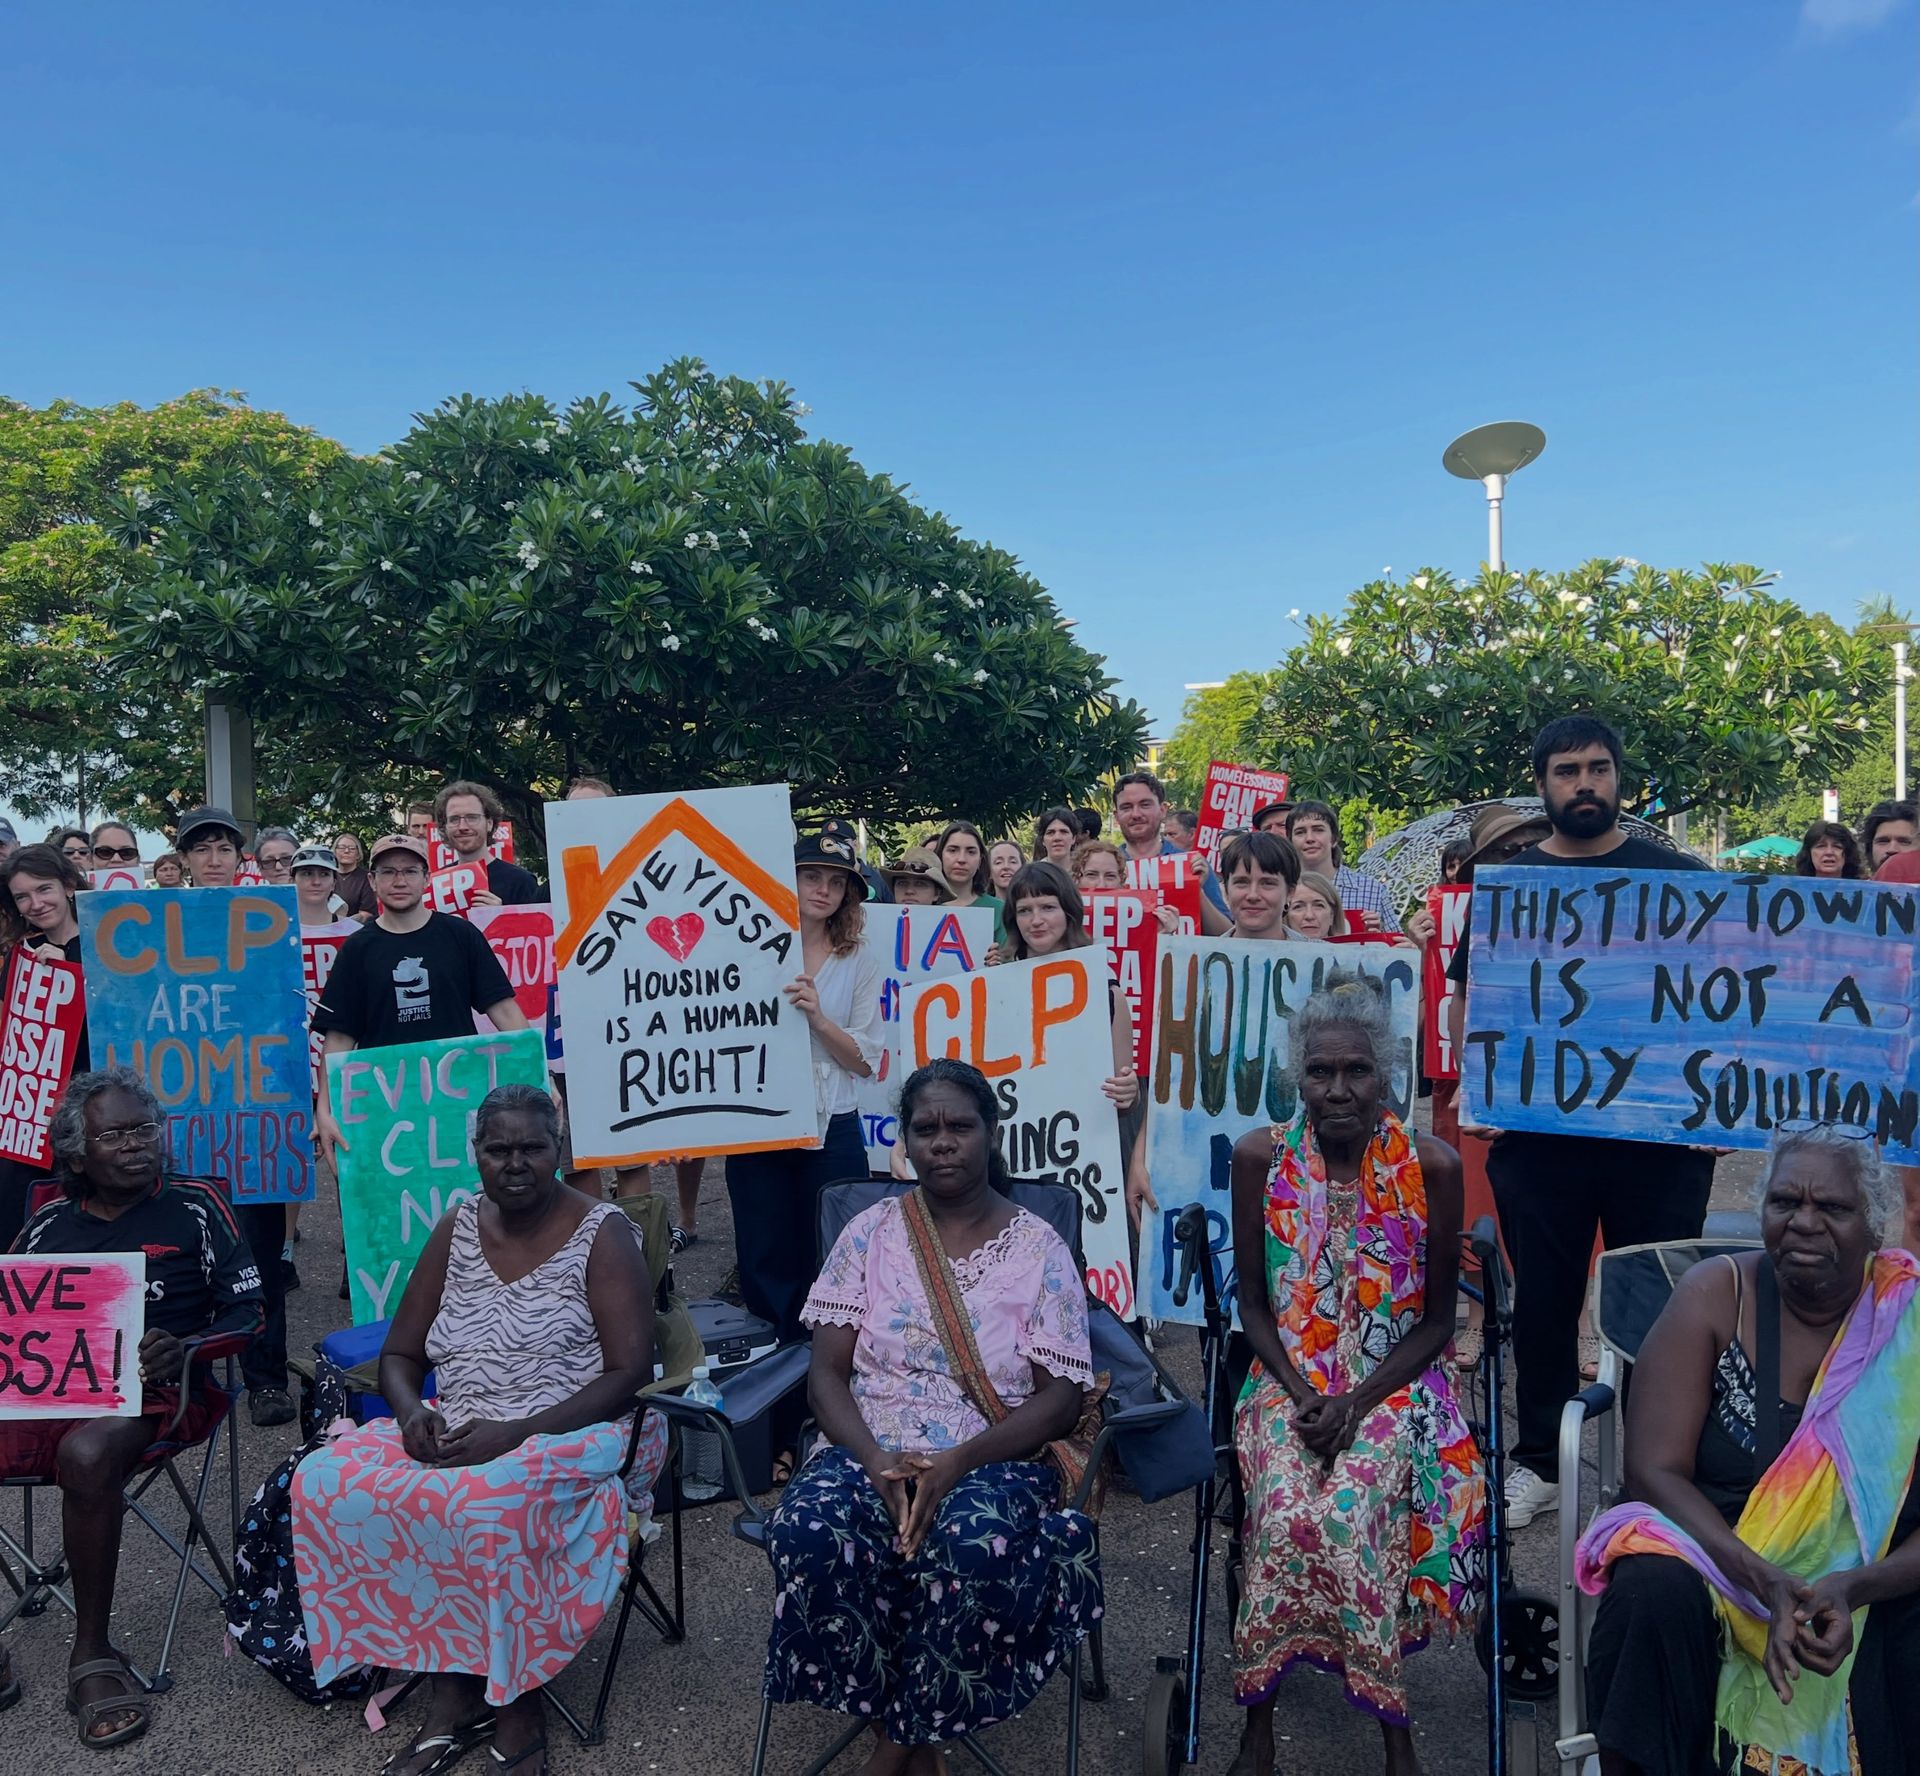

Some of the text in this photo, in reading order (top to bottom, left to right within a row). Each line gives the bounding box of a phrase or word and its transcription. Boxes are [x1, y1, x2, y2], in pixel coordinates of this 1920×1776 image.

[1210, 765, 1285, 793] HOMELESSNESS
[422, 869, 475, 914] EP
[1125, 854, 1189, 891] AN'T
[95, 895, 290, 976] CLP
[576, 849, 794, 977] SAVE YISSA
[1082, 896, 1144, 948] EP
[1476, 882, 1588, 949] THIS
[1593, 877, 1729, 946] TIDY
[1732, 874, 1917, 938] TOWN
[9, 953, 76, 1025] EEP
[302, 943, 338, 989] EP
[623, 962, 742, 1008] HOUSING
[1529, 957, 1588, 1029] IS
[1650, 962, 1778, 1029] NOT
[1818, 975, 1873, 1027] A
[146, 982, 243, 1034] ARE
[397, 1005, 431, 1017] JUSTICE
[397, 1011, 432, 1023] NOT JAILS
[605, 995, 780, 1045] IS A HUMAN
[912, 953, 1089, 1079] CLP
[1155, 950, 1413, 1123] HOUSG
[2, 1013, 65, 1079] SSA
[1466, 1030, 1645, 1115] TIDY
[0, 1068, 58, 1126] OSE
[340, 1043, 513, 1124] EVICT
[619, 1042, 767, 1113] RIGHT!
[0, 1115, 48, 1160] ARE
[166, 1110, 309, 1197] ECKERS
[0, 1267, 91, 1317] AVE
[0, 1329, 122, 1396] SSA!
